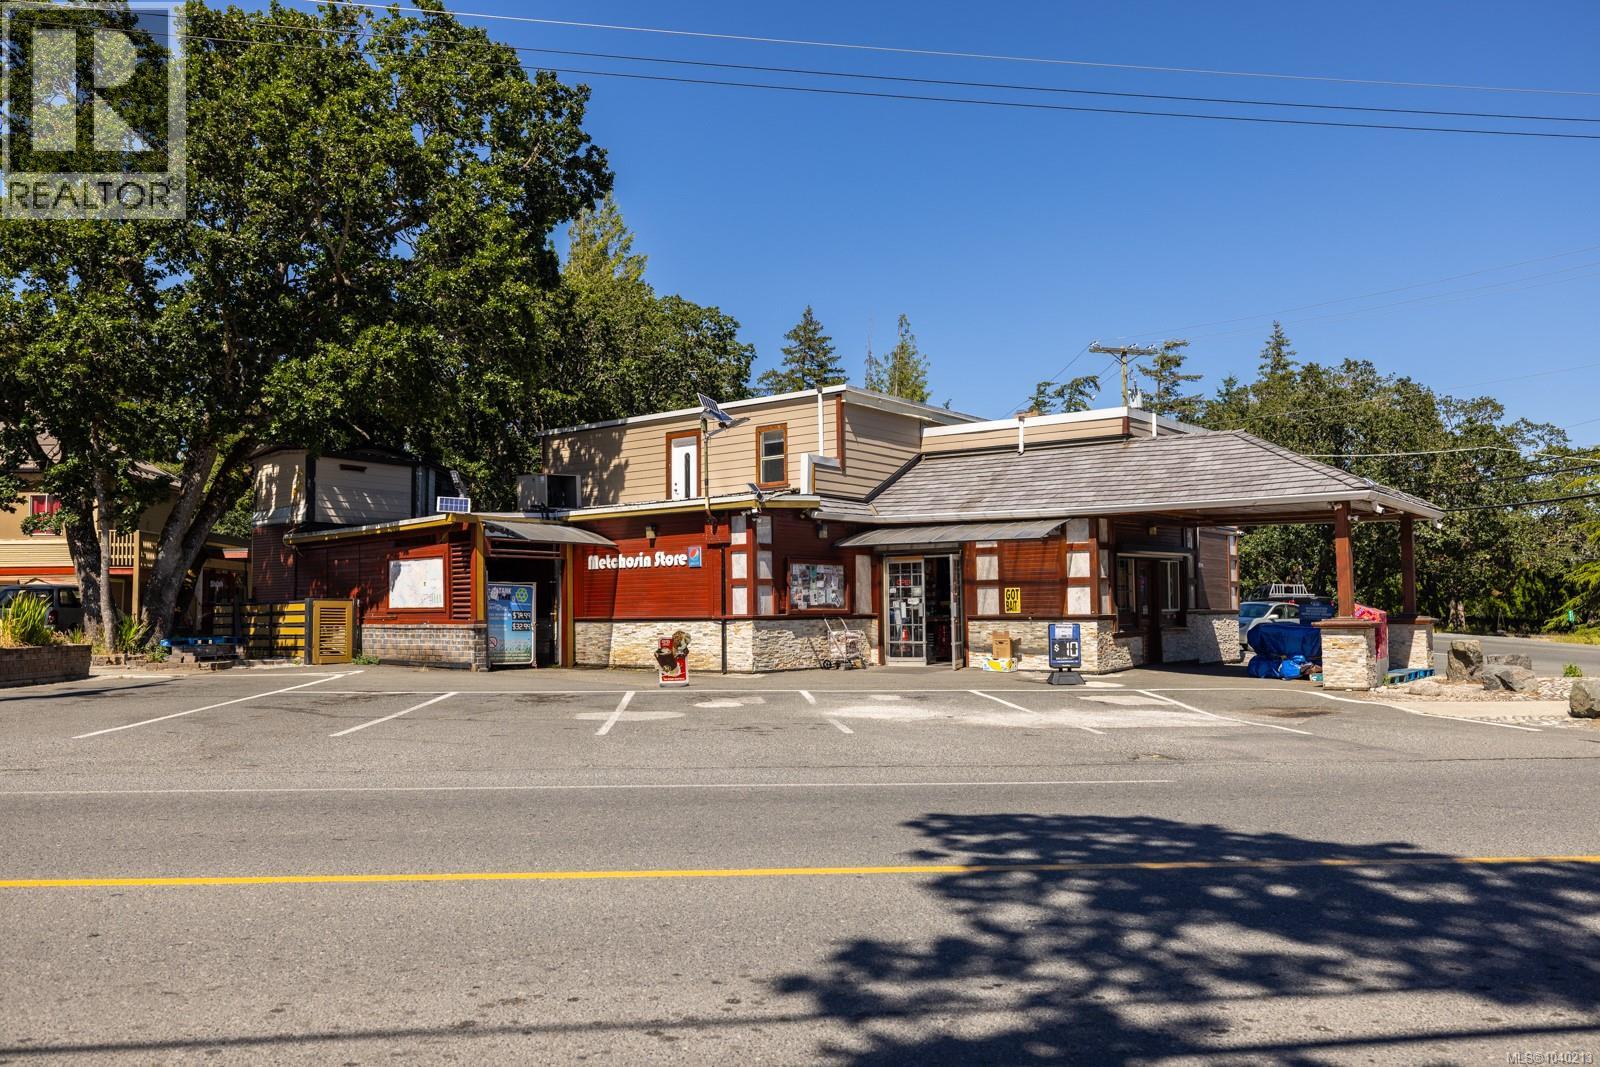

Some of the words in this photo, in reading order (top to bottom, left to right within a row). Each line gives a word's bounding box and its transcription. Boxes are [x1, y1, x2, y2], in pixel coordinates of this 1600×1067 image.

[588, 552, 652, 570] Metchosin
[654, 551, 688, 567] Store
[1006, 589, 1019, 600] GOT
[1006, 601, 1018, 612] BAIT
[1066, 641, 1079, 657] 10
